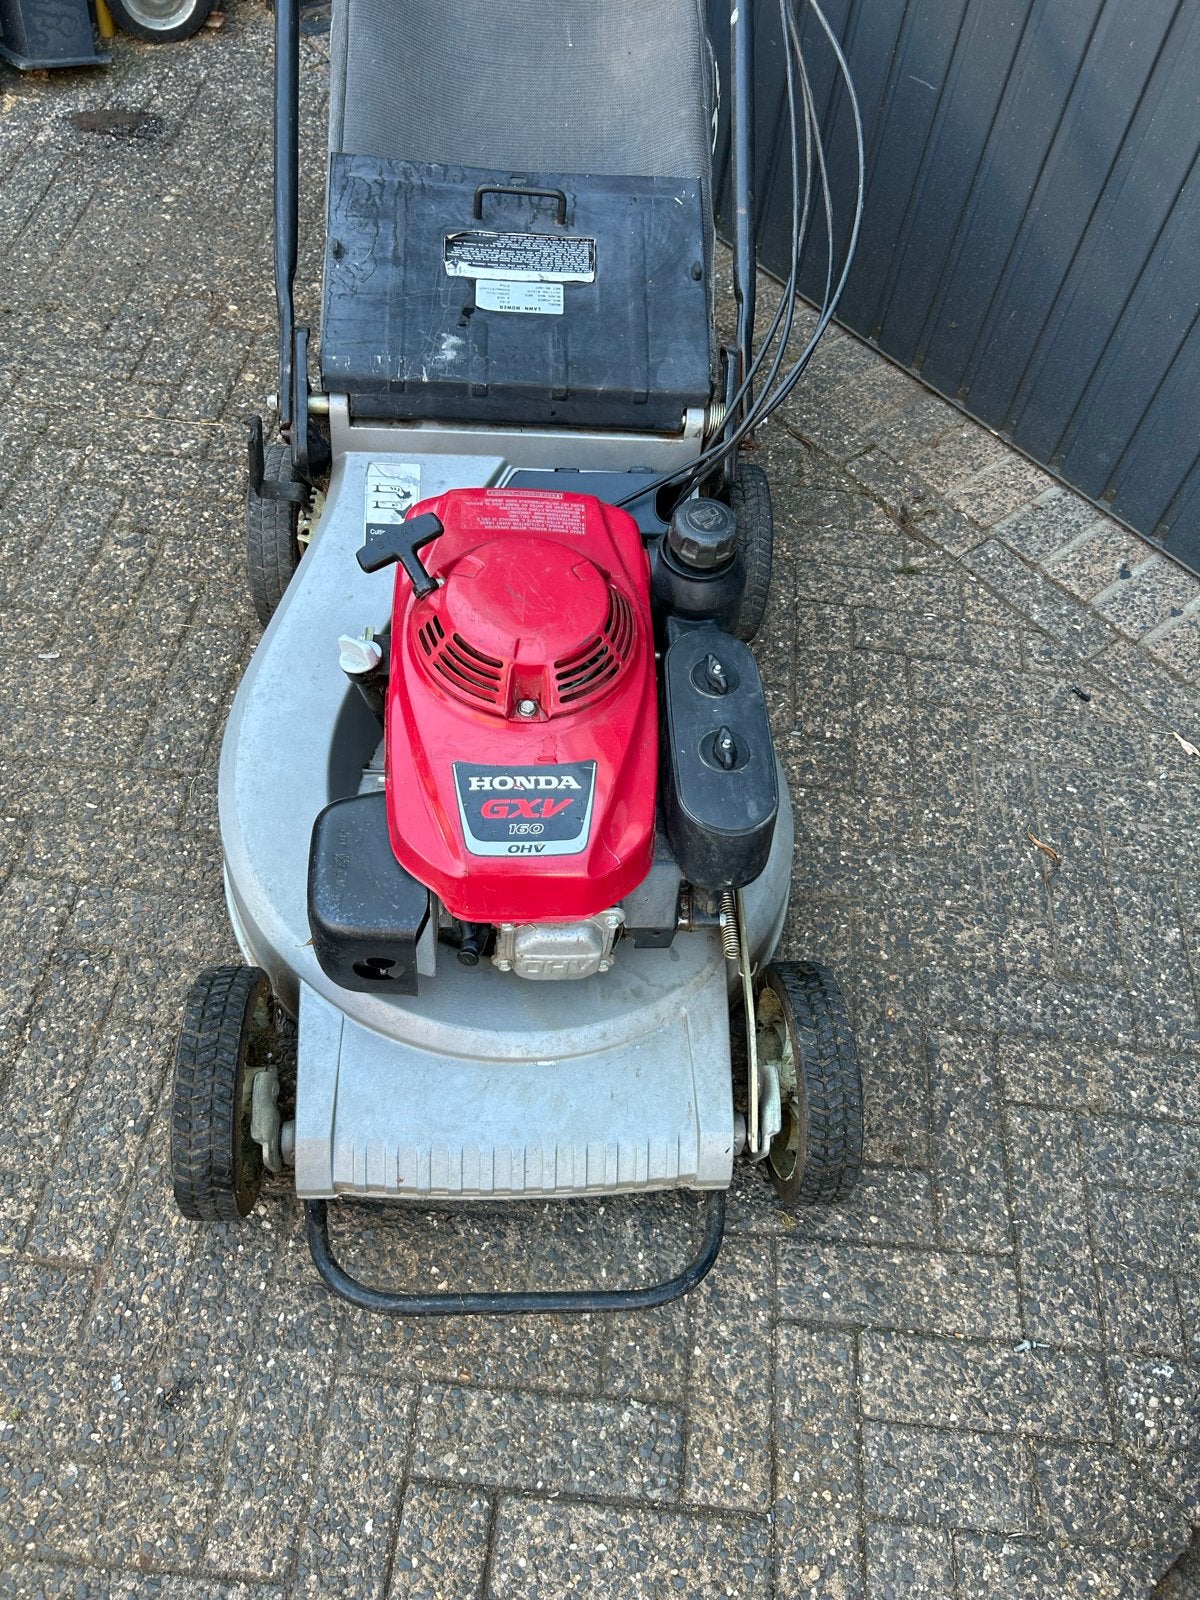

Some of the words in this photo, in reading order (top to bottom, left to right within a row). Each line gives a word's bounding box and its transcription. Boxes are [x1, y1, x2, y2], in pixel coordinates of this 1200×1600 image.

[468, 775, 581, 791] HONDA
[480, 798, 574, 819] GXV
[508, 823, 544, 835] 160
[508, 844, 546, 854] OHV
[526, 959, 594, 974] OHV
